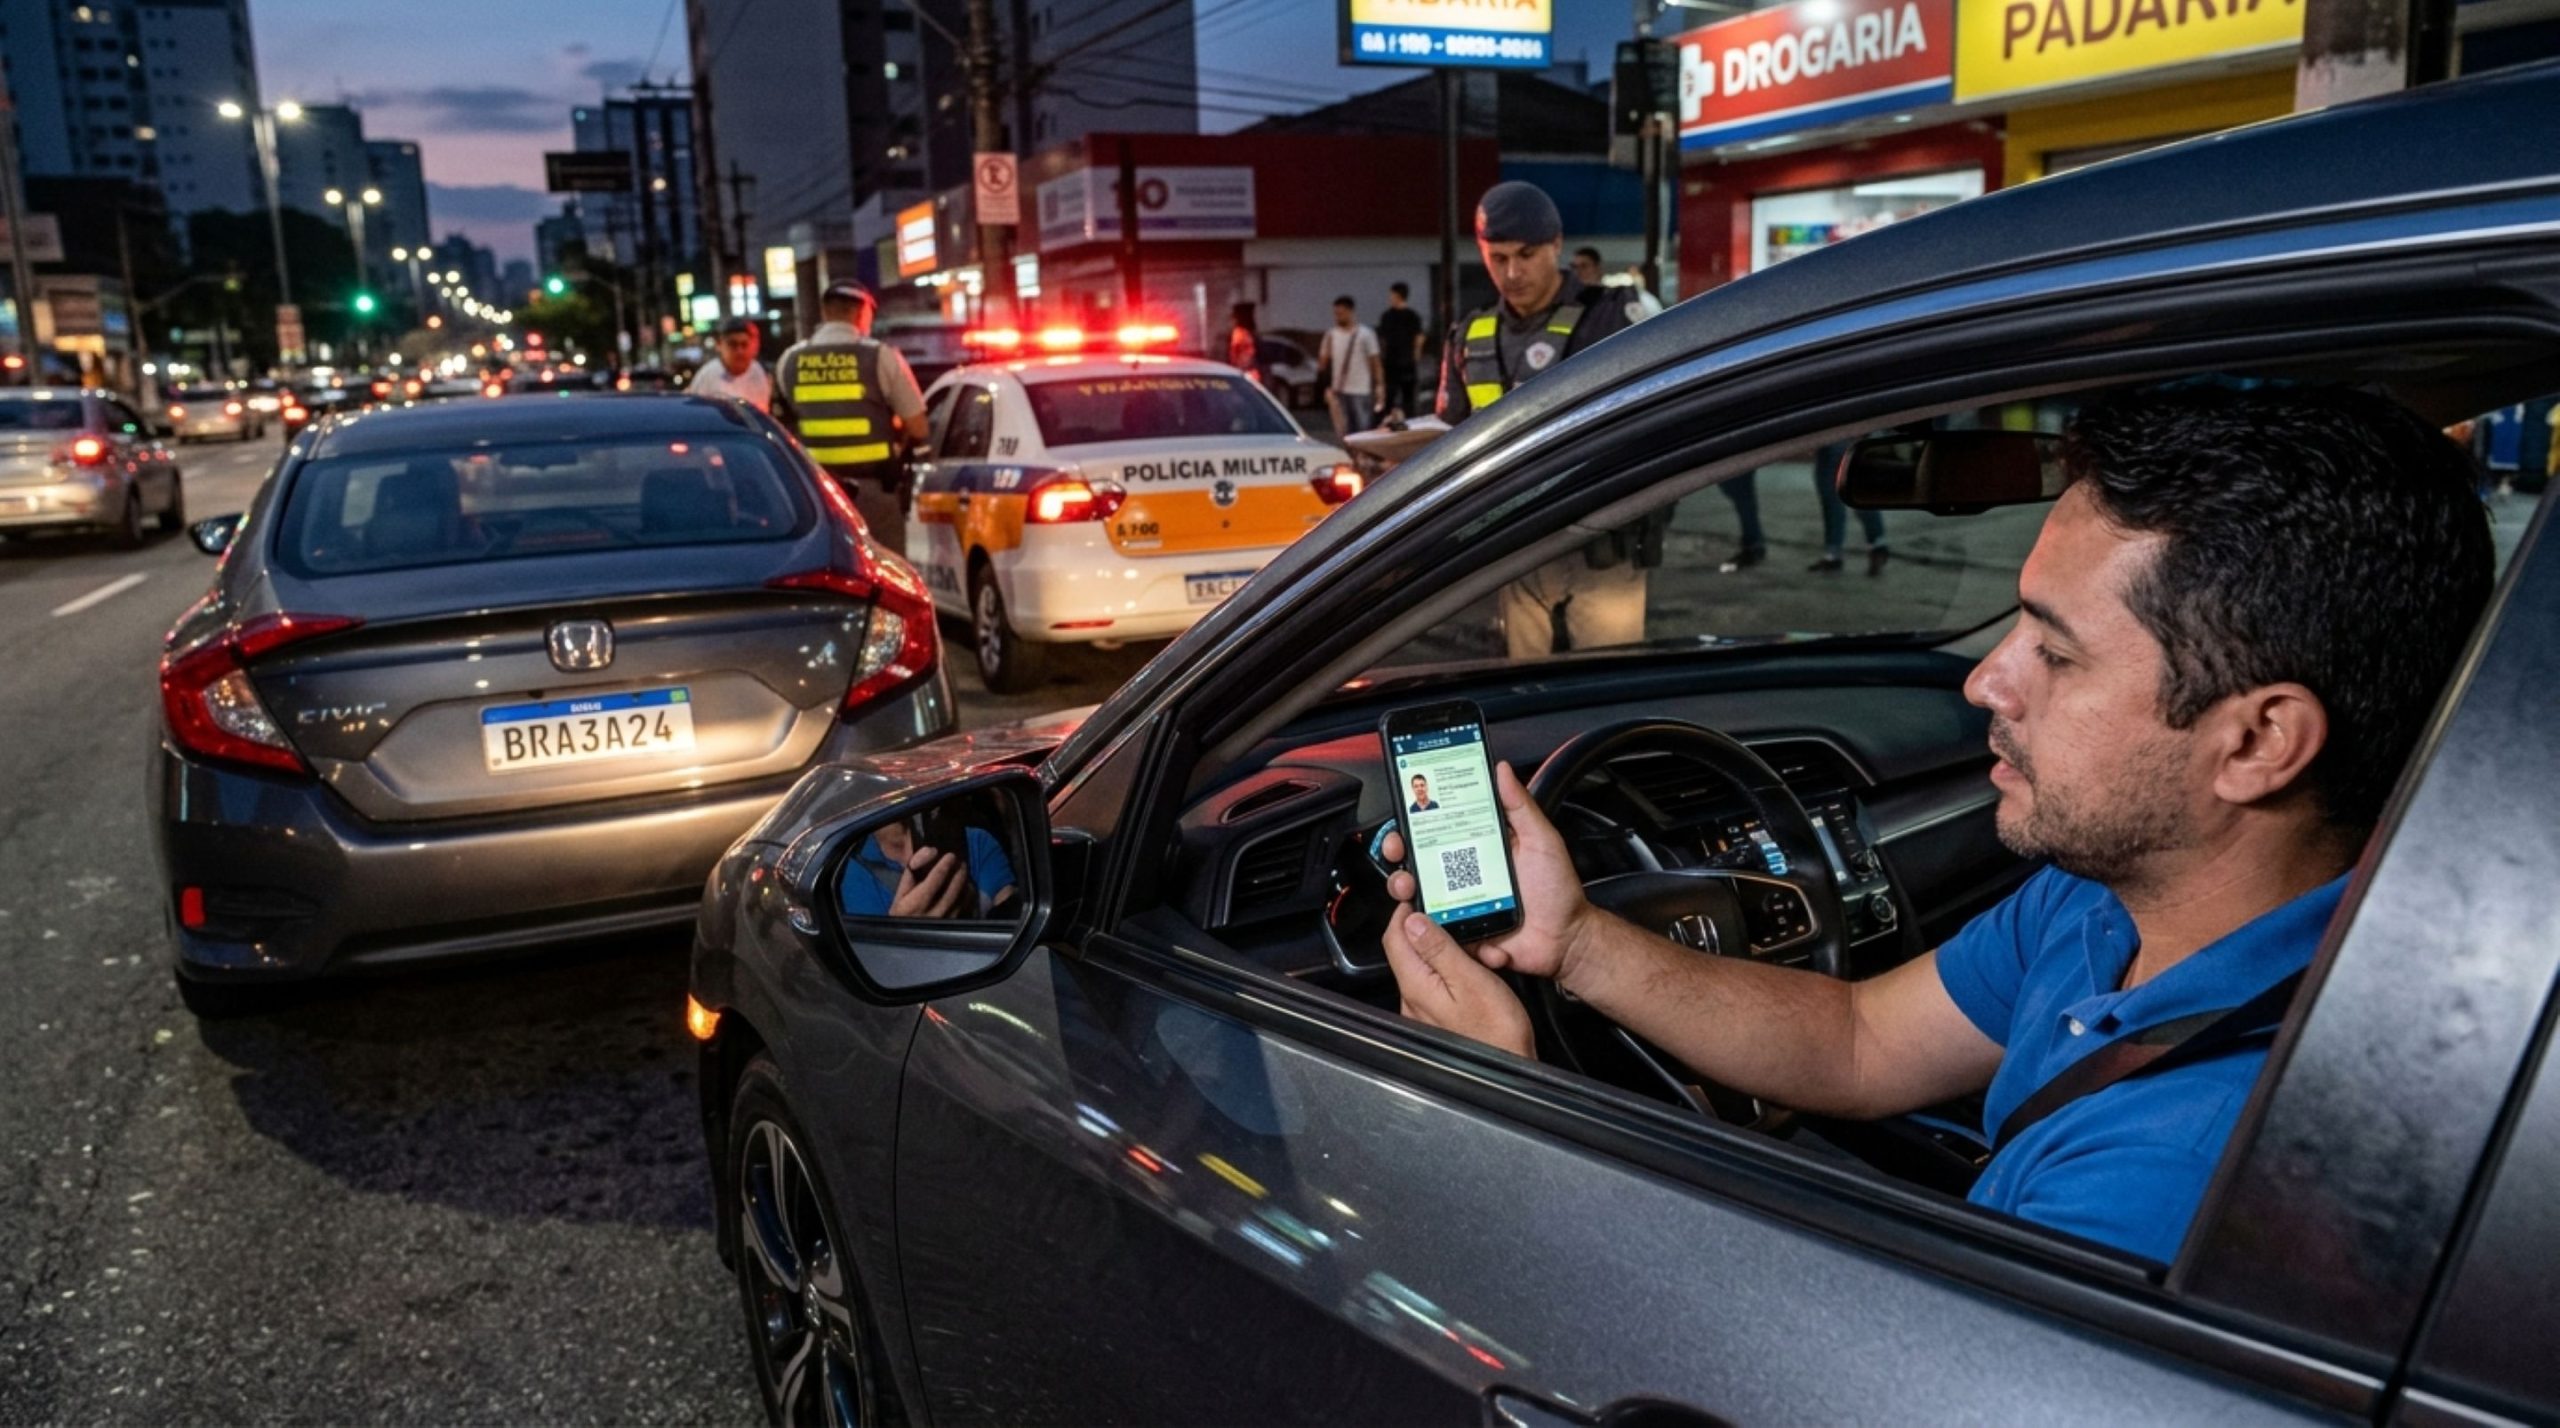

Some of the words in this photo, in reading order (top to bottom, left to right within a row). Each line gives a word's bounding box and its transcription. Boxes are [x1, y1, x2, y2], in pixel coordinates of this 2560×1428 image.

[1723, 2, 1926, 96] DROGARIA
[1123, 458, 1216, 482] POLÍCIA
[1223, 457, 1307, 476] MILITAR
[503, 710, 672, 761] BRA3A24
